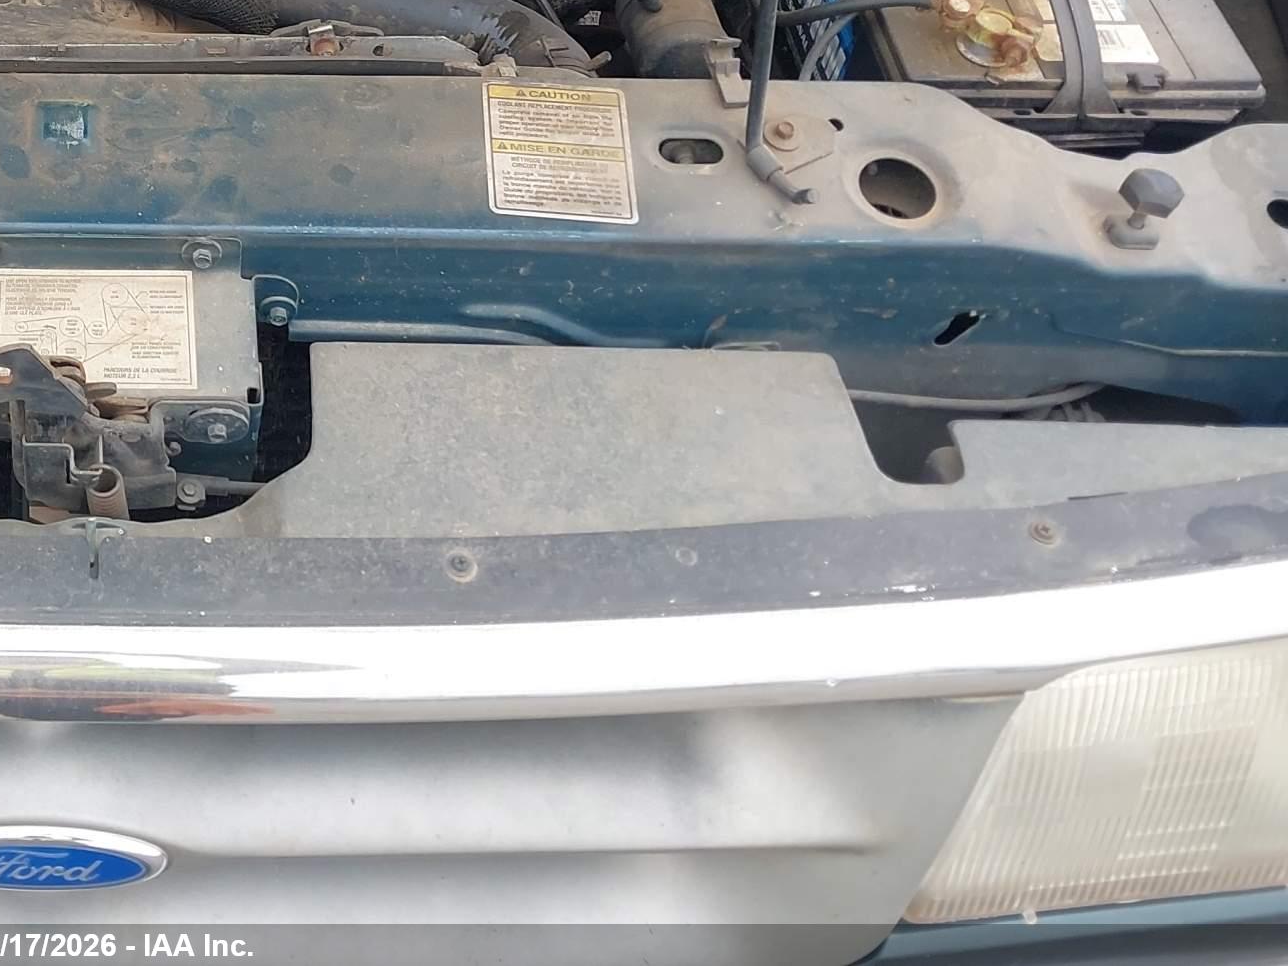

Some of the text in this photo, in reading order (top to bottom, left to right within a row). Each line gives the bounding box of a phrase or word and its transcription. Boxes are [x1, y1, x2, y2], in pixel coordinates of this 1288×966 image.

[529, 90, 591, 102] CAUTION
[510, 143, 622, 158] MISE EN GARDE
